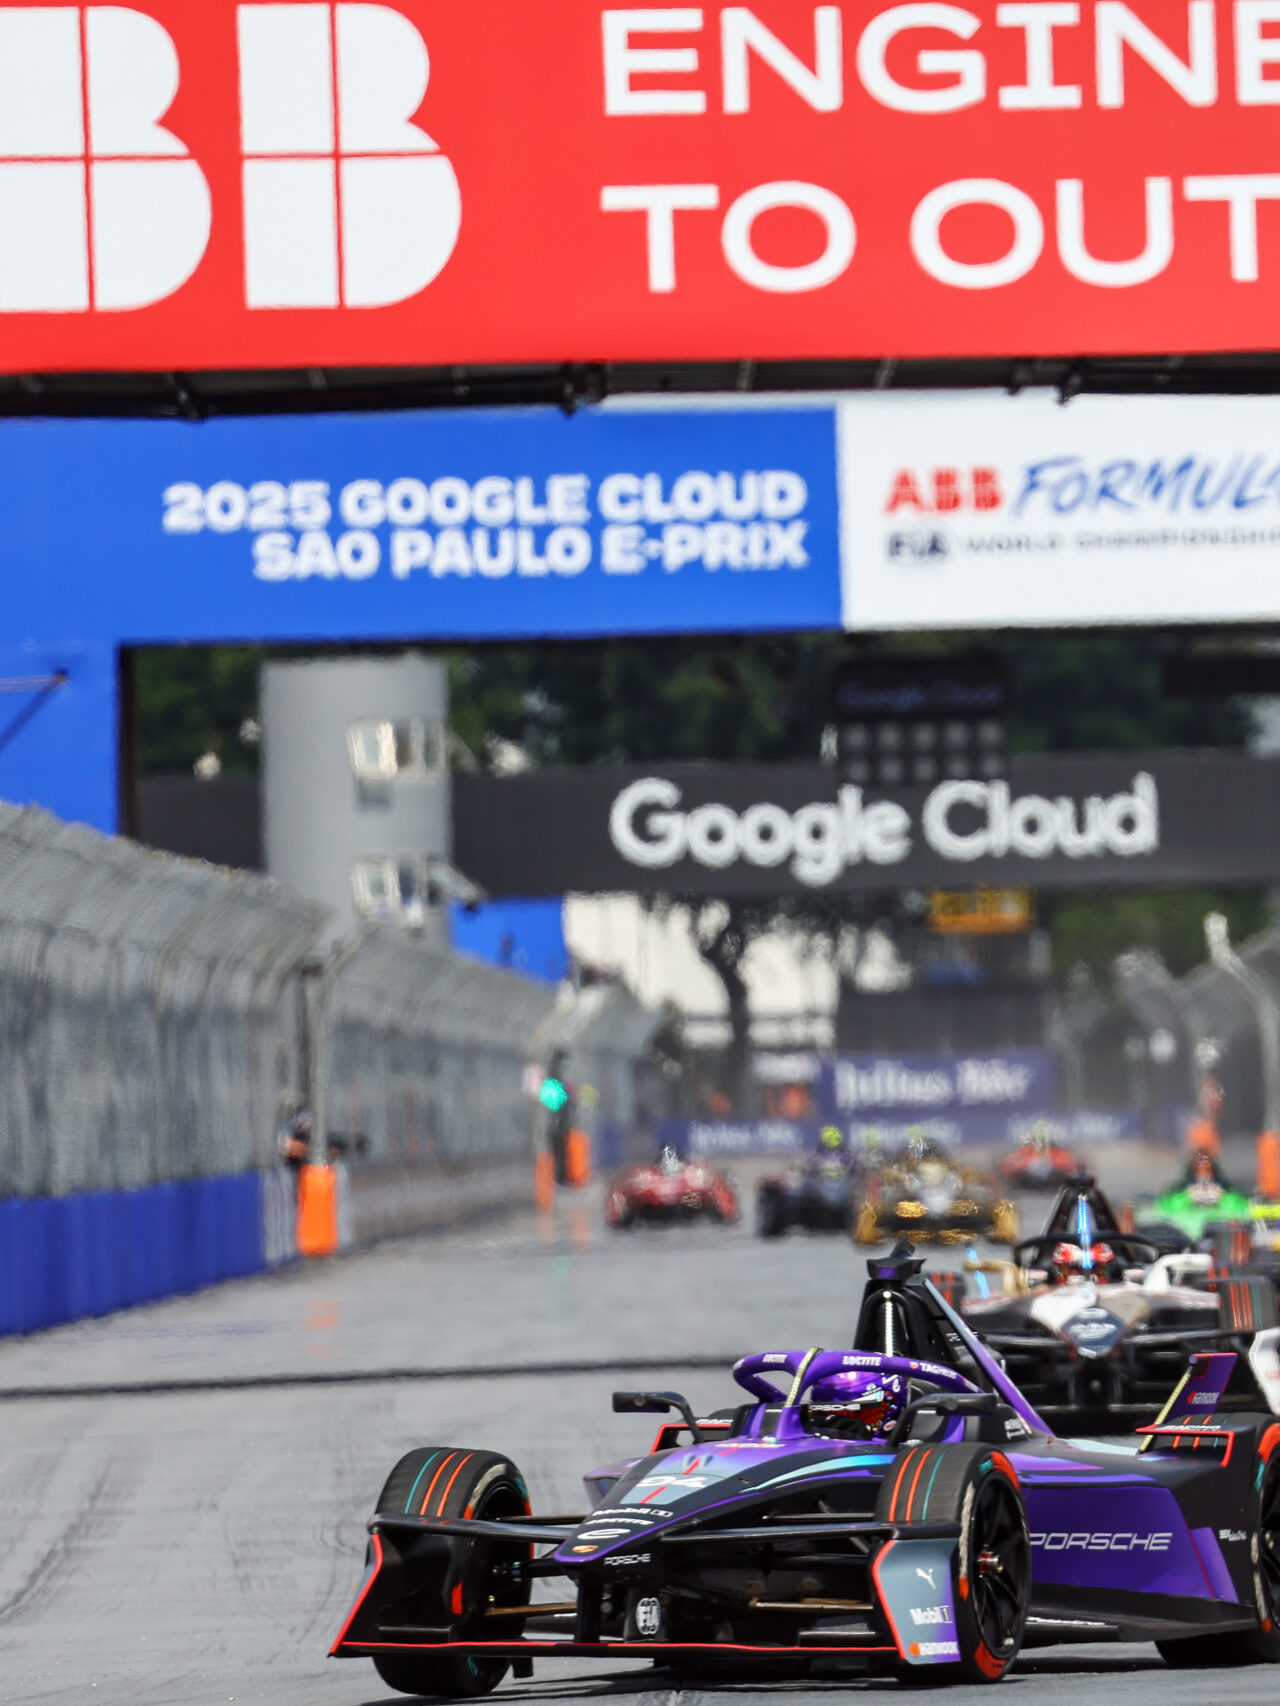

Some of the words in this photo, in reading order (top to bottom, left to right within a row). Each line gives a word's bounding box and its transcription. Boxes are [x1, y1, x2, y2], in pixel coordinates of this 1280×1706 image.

[600, 181, 857, 293] TO
[162, 481, 332, 533] 2025
[340, 473, 592, 527] GOOGLE
[598, 470, 809, 524] CLOUD
[884, 467, 1004, 515] ABB
[391, 523, 593, 579] PAULO
[601, 520, 810, 573] E-PRIX
[609, 777, 912, 887] Google
[922, 770, 1159, 860] Cloud
[809, 1403, 860, 1412] ORSCHE
[604, 1553, 651, 1566] PORSCHE
[1029, 1532, 1173, 1551] PORSCHE
